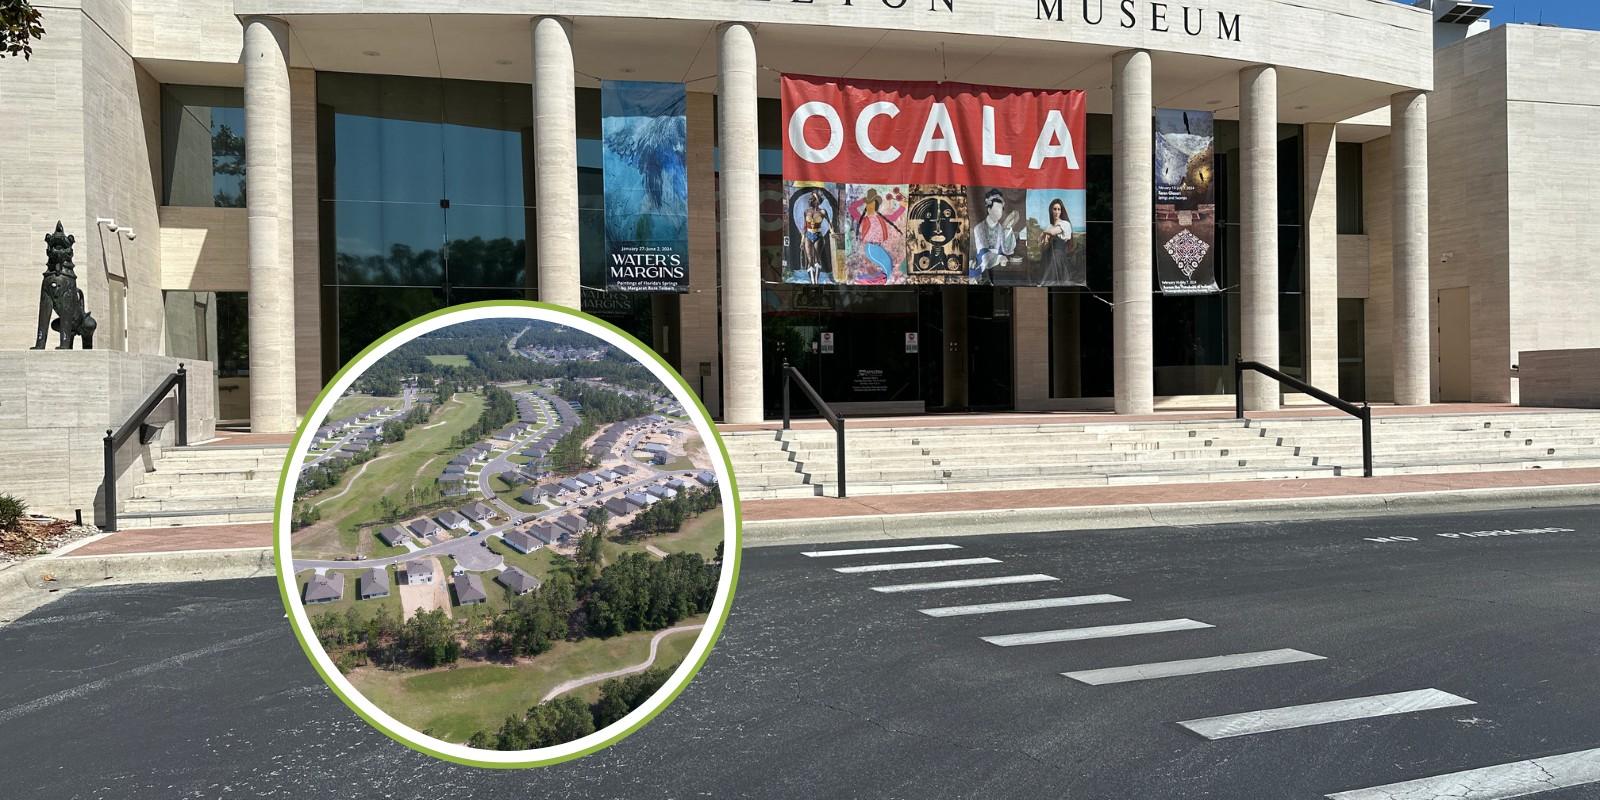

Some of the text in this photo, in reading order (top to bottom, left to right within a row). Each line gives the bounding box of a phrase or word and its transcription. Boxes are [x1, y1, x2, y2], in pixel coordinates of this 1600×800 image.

[1036, 0, 1243, 42] MUSEUM
[789, 100, 1080, 169] OCALA
[611, 254, 681, 266] WATER'S
[610, 266, 684, 278] MARGINS
[1363, 527, 1576, 543] NO PARKING
